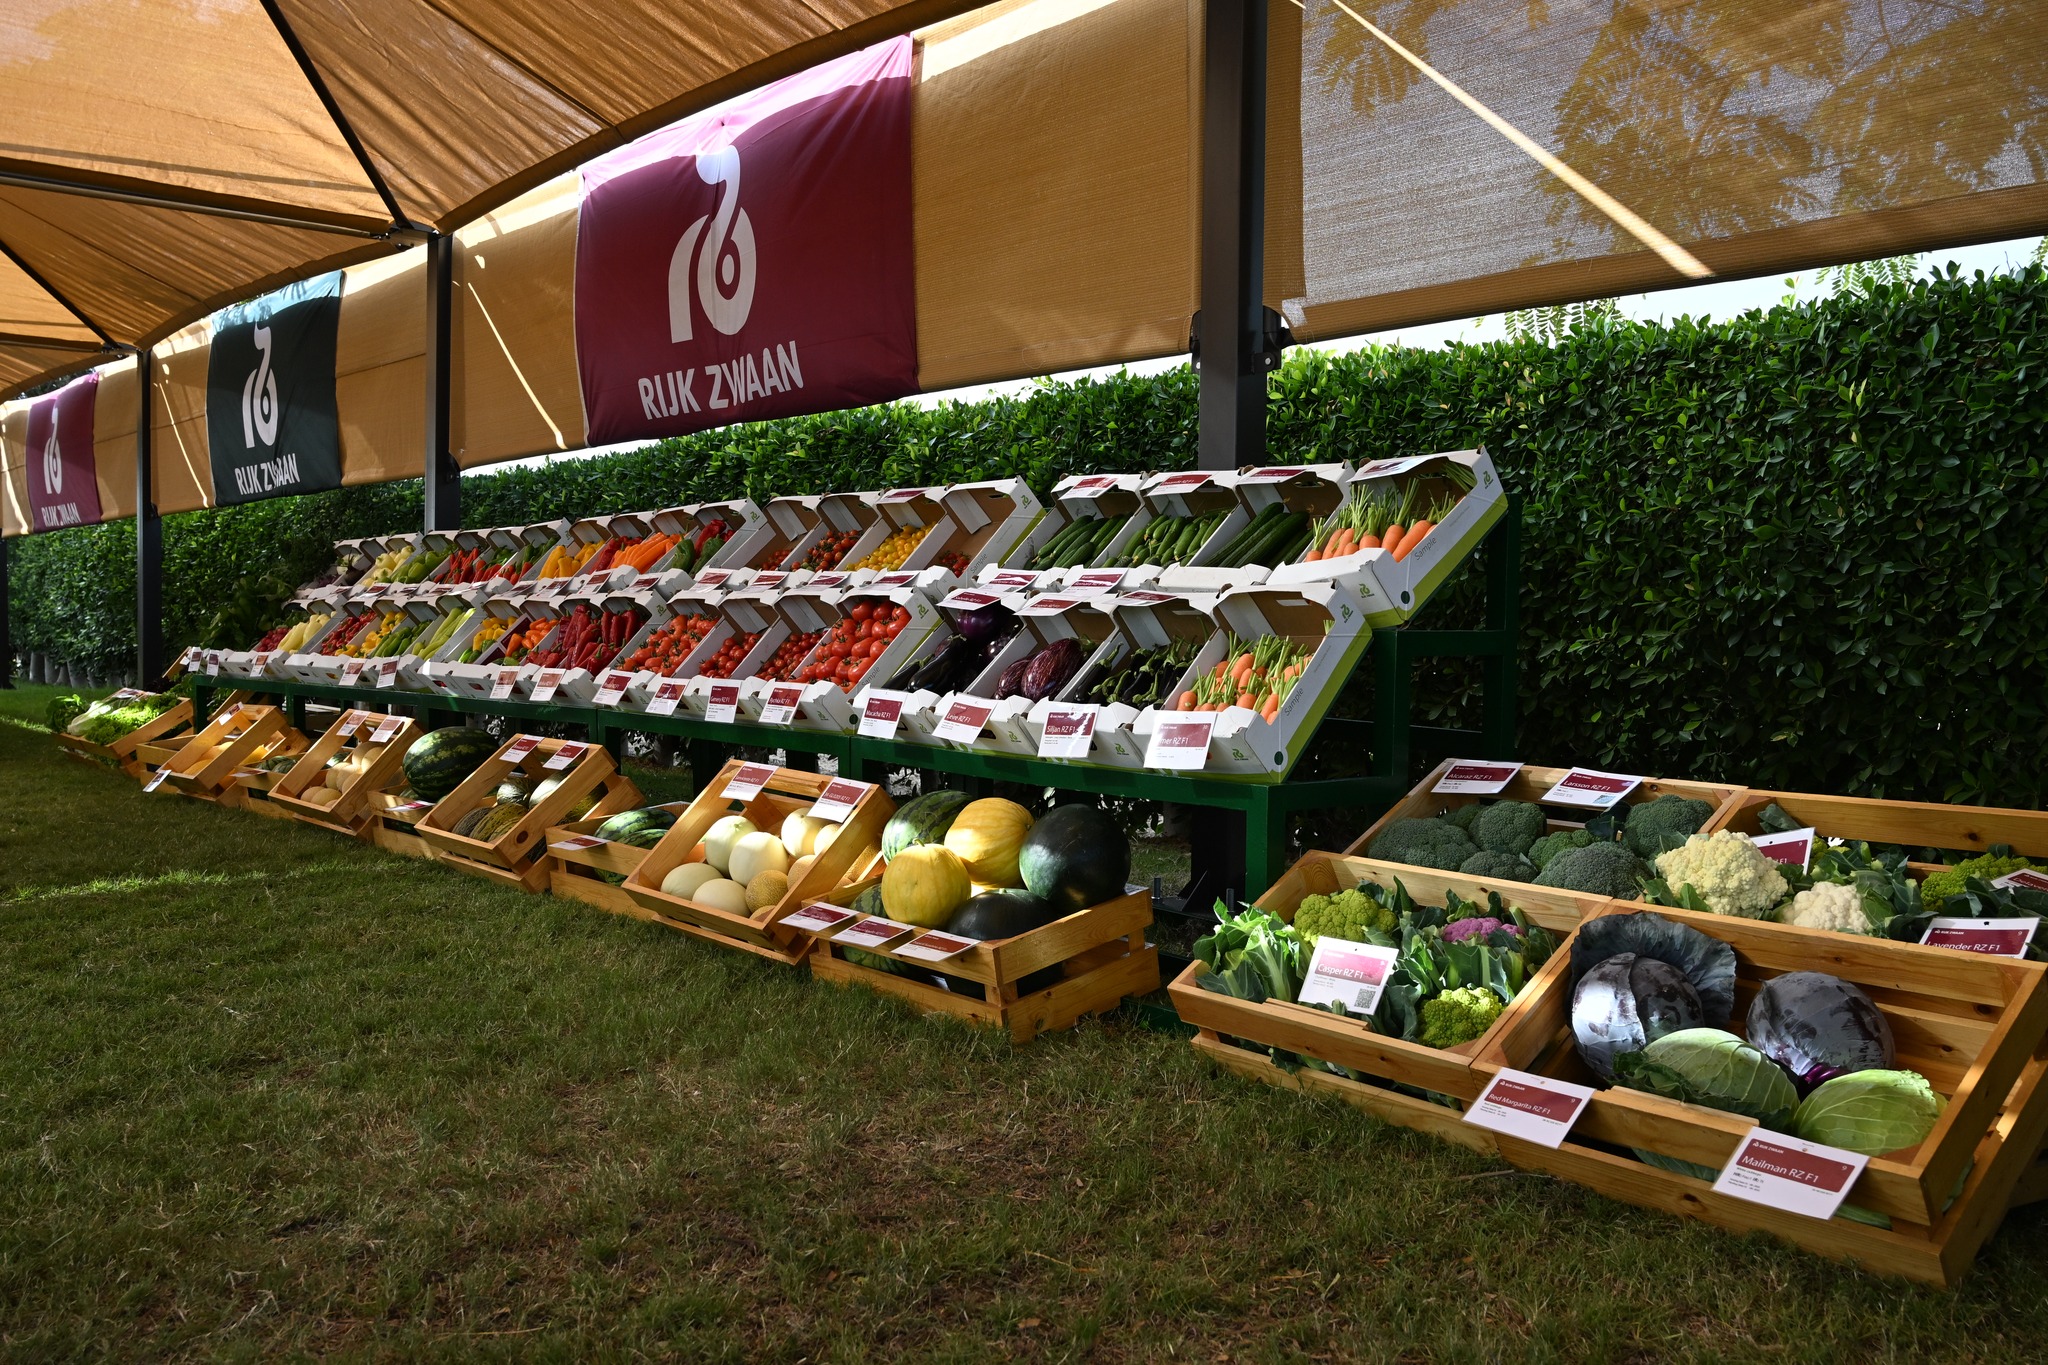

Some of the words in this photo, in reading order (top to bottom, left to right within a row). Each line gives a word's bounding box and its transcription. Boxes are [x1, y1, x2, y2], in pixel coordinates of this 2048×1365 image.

[637, 368, 702, 421] RIJK
[704, 340, 804, 410] ZWAAN
[234, 464, 262, 495] RIJK
[260, 453, 301, 491] ZWAAN
[41, 506, 60, 527] RIJK
[1414, 537, 1437, 561] Sample
[970, 553, 988, 574] Sample
[1284, 687, 1304, 716] Sample
[1172, 737, 1182, 745] RZ
[1181, 737, 1189, 745] F1
[1563, 781, 1590, 789] Larsson
[1927, 941, 1972, 951] Lavender
[1988, 944, 2001, 952] F1
[1317, 963, 1343, 976] Casper
[1343, 967, 1354, 978] RZ
[1354, 970, 1364, 979] F1
[1489, 1093, 1502, 1102] Red
[1501, 1095, 1532, 1110] Margarita
[1532, 1103, 1543, 1113] RZ
[1542, 1106, 1551, 1115] F1
[1741, 1155, 1787, 1175] Mailman
[1788, 1168, 1805, 1179] RZ
[1804, 1172, 1819, 1183] F1
